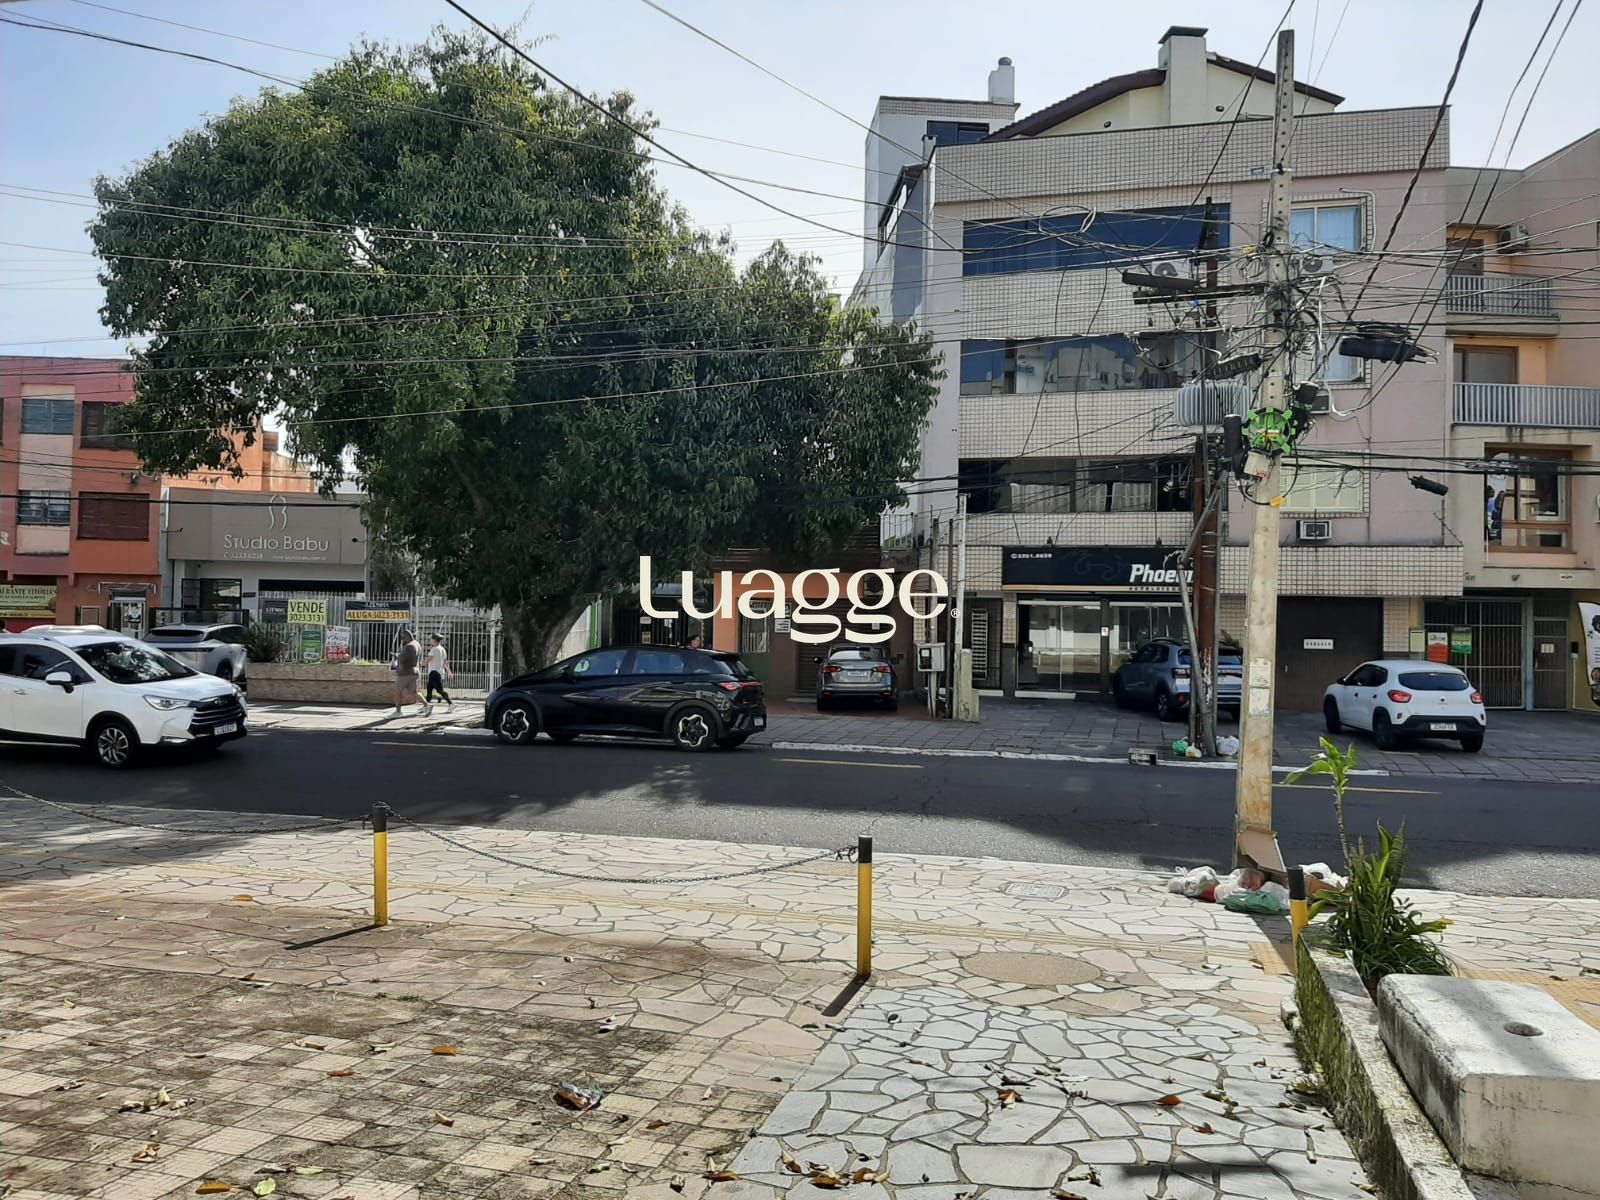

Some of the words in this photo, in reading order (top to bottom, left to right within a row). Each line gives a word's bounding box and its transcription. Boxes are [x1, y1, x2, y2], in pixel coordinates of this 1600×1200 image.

[224, 534, 279, 550] Studio
[283, 535, 329, 551] Babu
[1129, 564, 1194, 583] Phoei
[290, 601, 325, 613] VENDE
[347, 611, 373, 619] ALUGA
